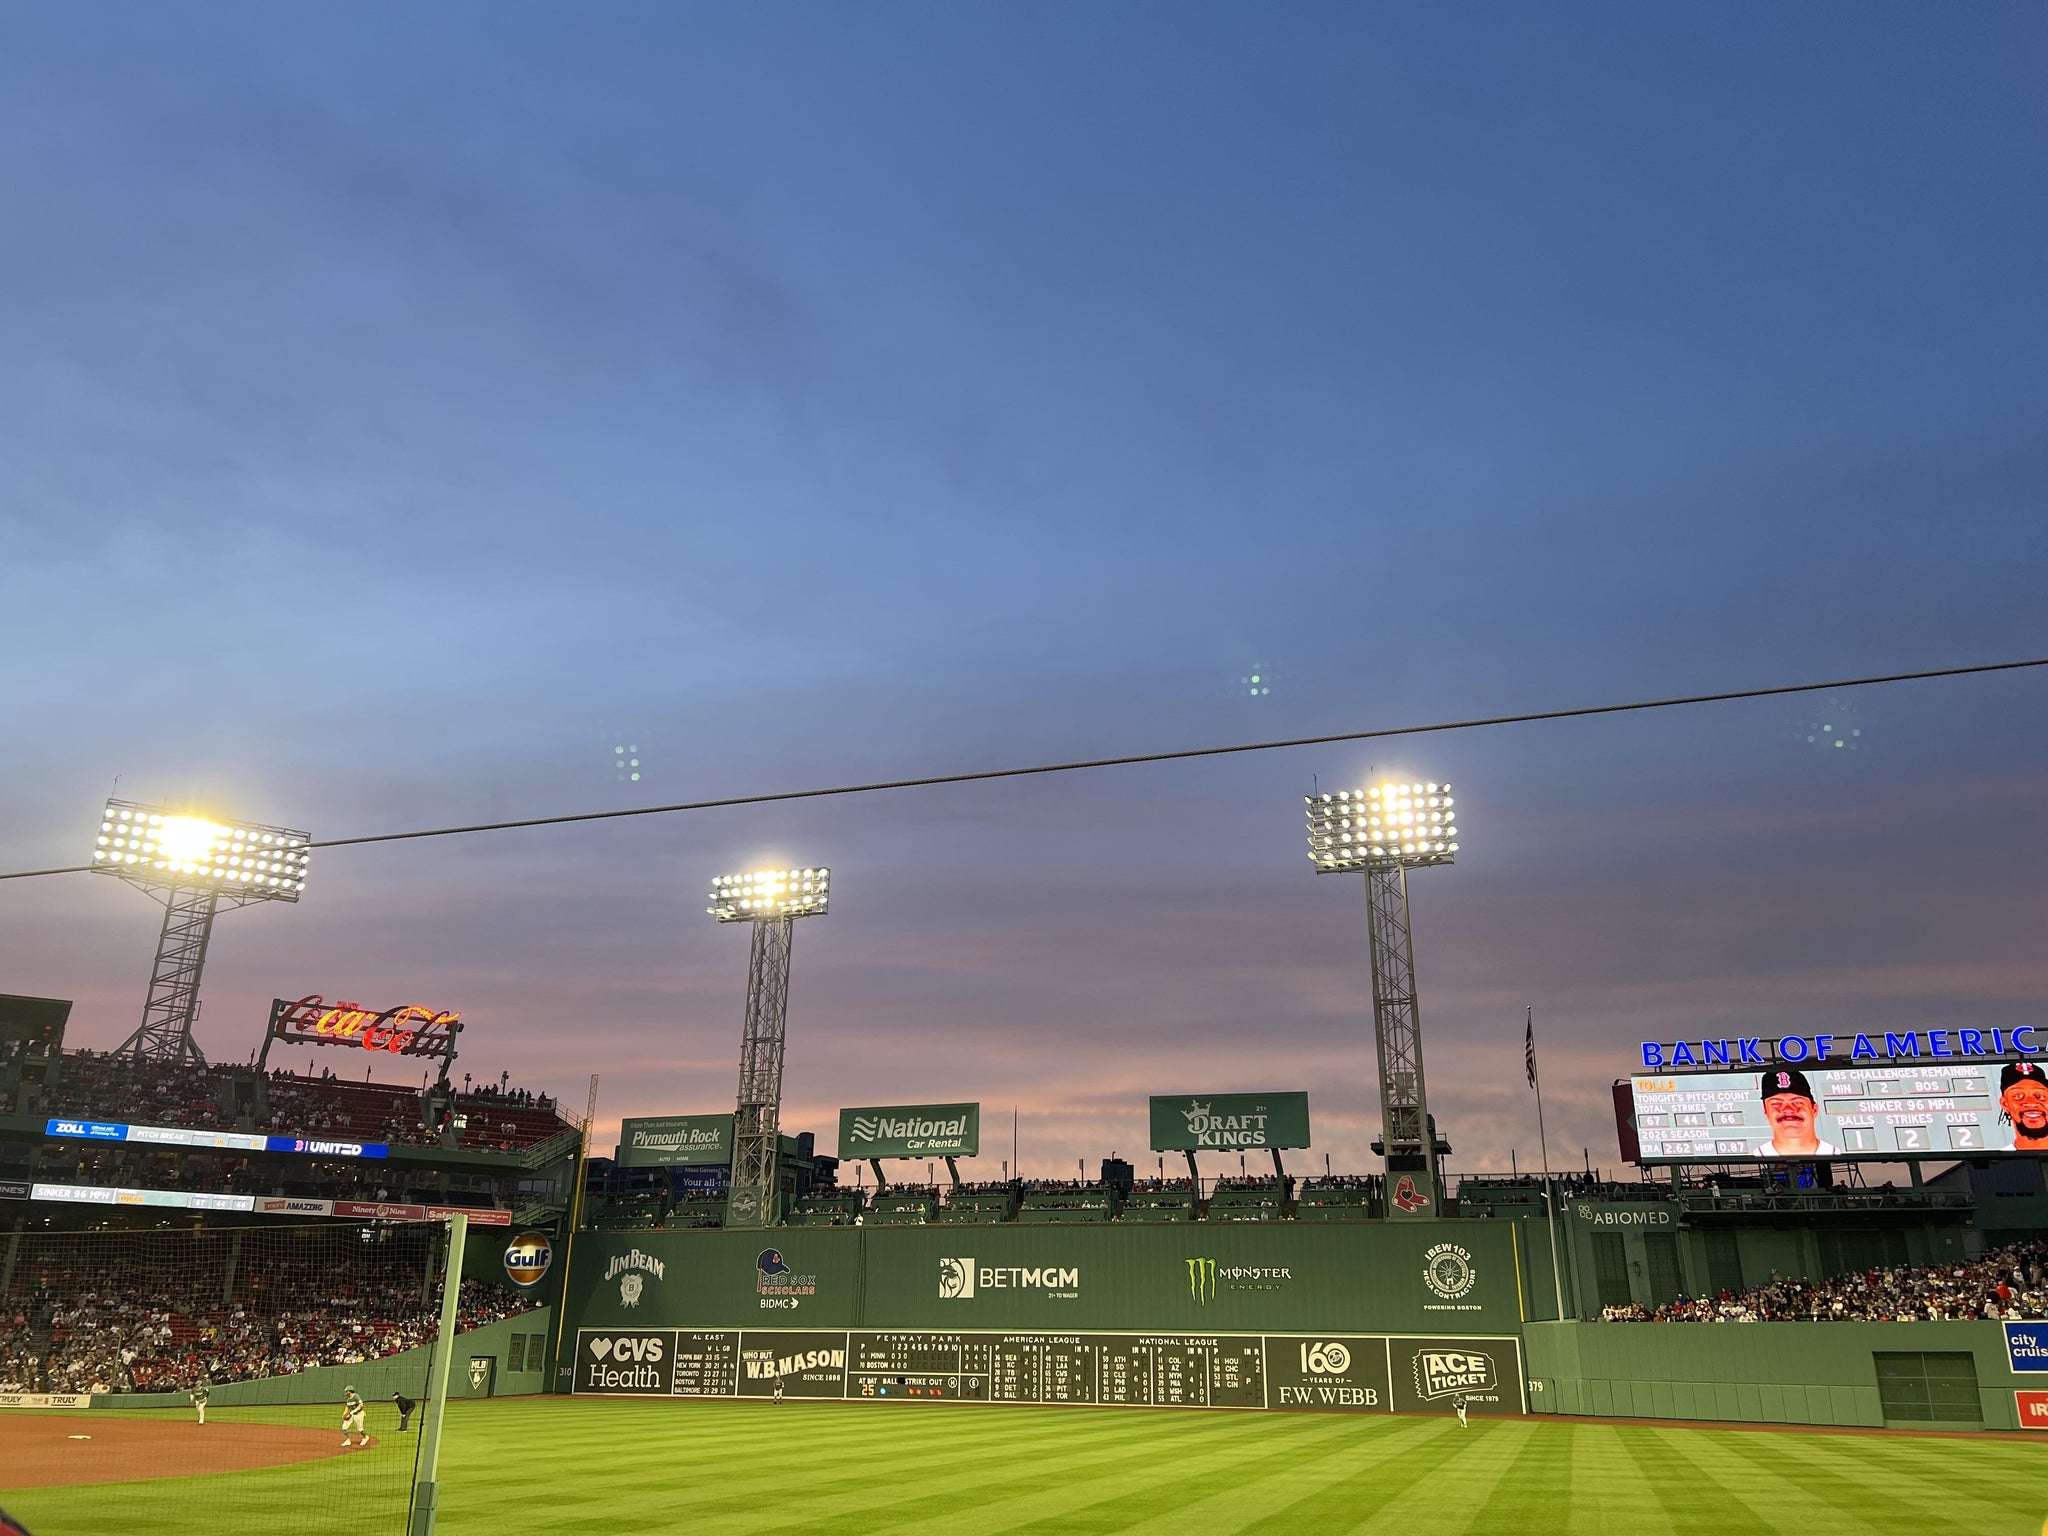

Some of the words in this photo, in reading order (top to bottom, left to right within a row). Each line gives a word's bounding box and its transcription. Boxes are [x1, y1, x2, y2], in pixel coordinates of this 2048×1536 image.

[276, 994, 460, 1055] Coca-Cola
[1640, 1037, 1765, 1068] BANK
[1778, 1034, 1834, 1062] OF
[1850, 1026, 2048, 1060] AMERIC
[1825, 1070, 1846, 1080] ABS
[1850, 1068, 1918, 1080] CHALLENGES
[1922, 1067, 1978, 1078] REMAINING
[1636, 1080, 1676, 1091] TOLLE
[1831, 1084, 1852, 1094] MIN
[1880, 1082, 1888, 1093] 2
[1915, 1081, 1939, 1092] BOS
[1966, 1080, 1974, 1090] 2
[1637, 1094, 1684, 1104] TONIGHT'S
[1687, 1092, 1714, 1101] PITCH
[1718, 1092, 1749, 1100] COUNT
[1639, 1105, 1666, 1113] TOTAL
[1672, 1104, 1706, 1112] STRIKES
[1859, 1100, 1902, 1112] SINKER
[1907, 1100, 1924, 1110] 96
[1928, 1099, 1954, 1110] MPH
[1188, 1115, 1268, 1134] DRAFT
[1646, 1116, 1660, 1126] 67
[1684, 1116, 1698, 1124] 44
[1720, 1114, 1735, 1123] 66
[1837, 1115, 1875, 1126] BALLS
[1886, 1114, 1934, 1124] STRIKES
[1946, 1112, 1978, 1122] OUTS
[56, 1123, 86, 1134] ZOLL
[877, 1115, 966, 1138] National
[138, 1130, 158, 1138] PITCH
[160, 1132, 184, 1140] BREAK
[632, 1130, 688, 1146] Plymouth
[690, 1128, 720, 1142] Rock
[1198, 1130, 1266, 1146] KINGS
[1642, 1131, 1667, 1140] 2026
[1670, 1130, 1709, 1138] SEASON
[1855, 1130, 1864, 1148] 1
[1904, 1130, 1920, 1148] 2
[1958, 1128, 1974, 1147] 2
[310, 1142, 362, 1156] UNITED
[907, 1140, 924, 1148] Car
[928, 1138, 962, 1148] Rental
[1642, 1144, 1660, 1153] ERA
[1666, 1144, 1690, 1154] 2.62
[1695, 1144, 1714, 1152] WHIP
[1720, 1143, 1744, 1152] 0.87
[683, 1178, 701, 1186] Your
[38, 1188, 70, 1197] SINKER
[90, 1191, 109, 1200] MPH
[286, 1202, 323, 1212] AMAZING
[352, 1206, 376, 1214] Ninety
[1594, 1212, 1670, 1224] ABIOMED
[507, 1249, 549, 1266] Gulf
[1424, 1243, 1452, 1260] IBEW
[1453, 1245, 1471, 1261] 103
[980, 1268, 1078, 1288] BETMGM
[1219, 1266, 1292, 1280] MONSTER
[762, 1276, 788, 1285] RED
[790, 1275, 816, 1285] SOX
[1423, 1270, 1434, 1290] NECA
[1434, 1269, 1476, 1299] CONTRACTORS
[761, 1286, 816, 1295] SCHOLARS
[760, 1299, 789, 1308] BIDMC
[2011, 1334, 2037, 1347] city
[613, 1338, 663, 1362] CVS
[471, 1360, 486, 1369] MLB
[778, 1350, 845, 1376] MASON
[1300, 1342, 1351, 1374] 160
[1430, 1354, 1486, 1375] ACE
[560, 1368, 572, 1376] 310
[588, 1365, 660, 1388] Health
[1432, 1374, 1487, 1390] TICKET
[862, 1386, 874, 1396] 25
[1279, 1387, 1314, 1404] F.W.
[1318, 1388, 1378, 1405] WEBB
